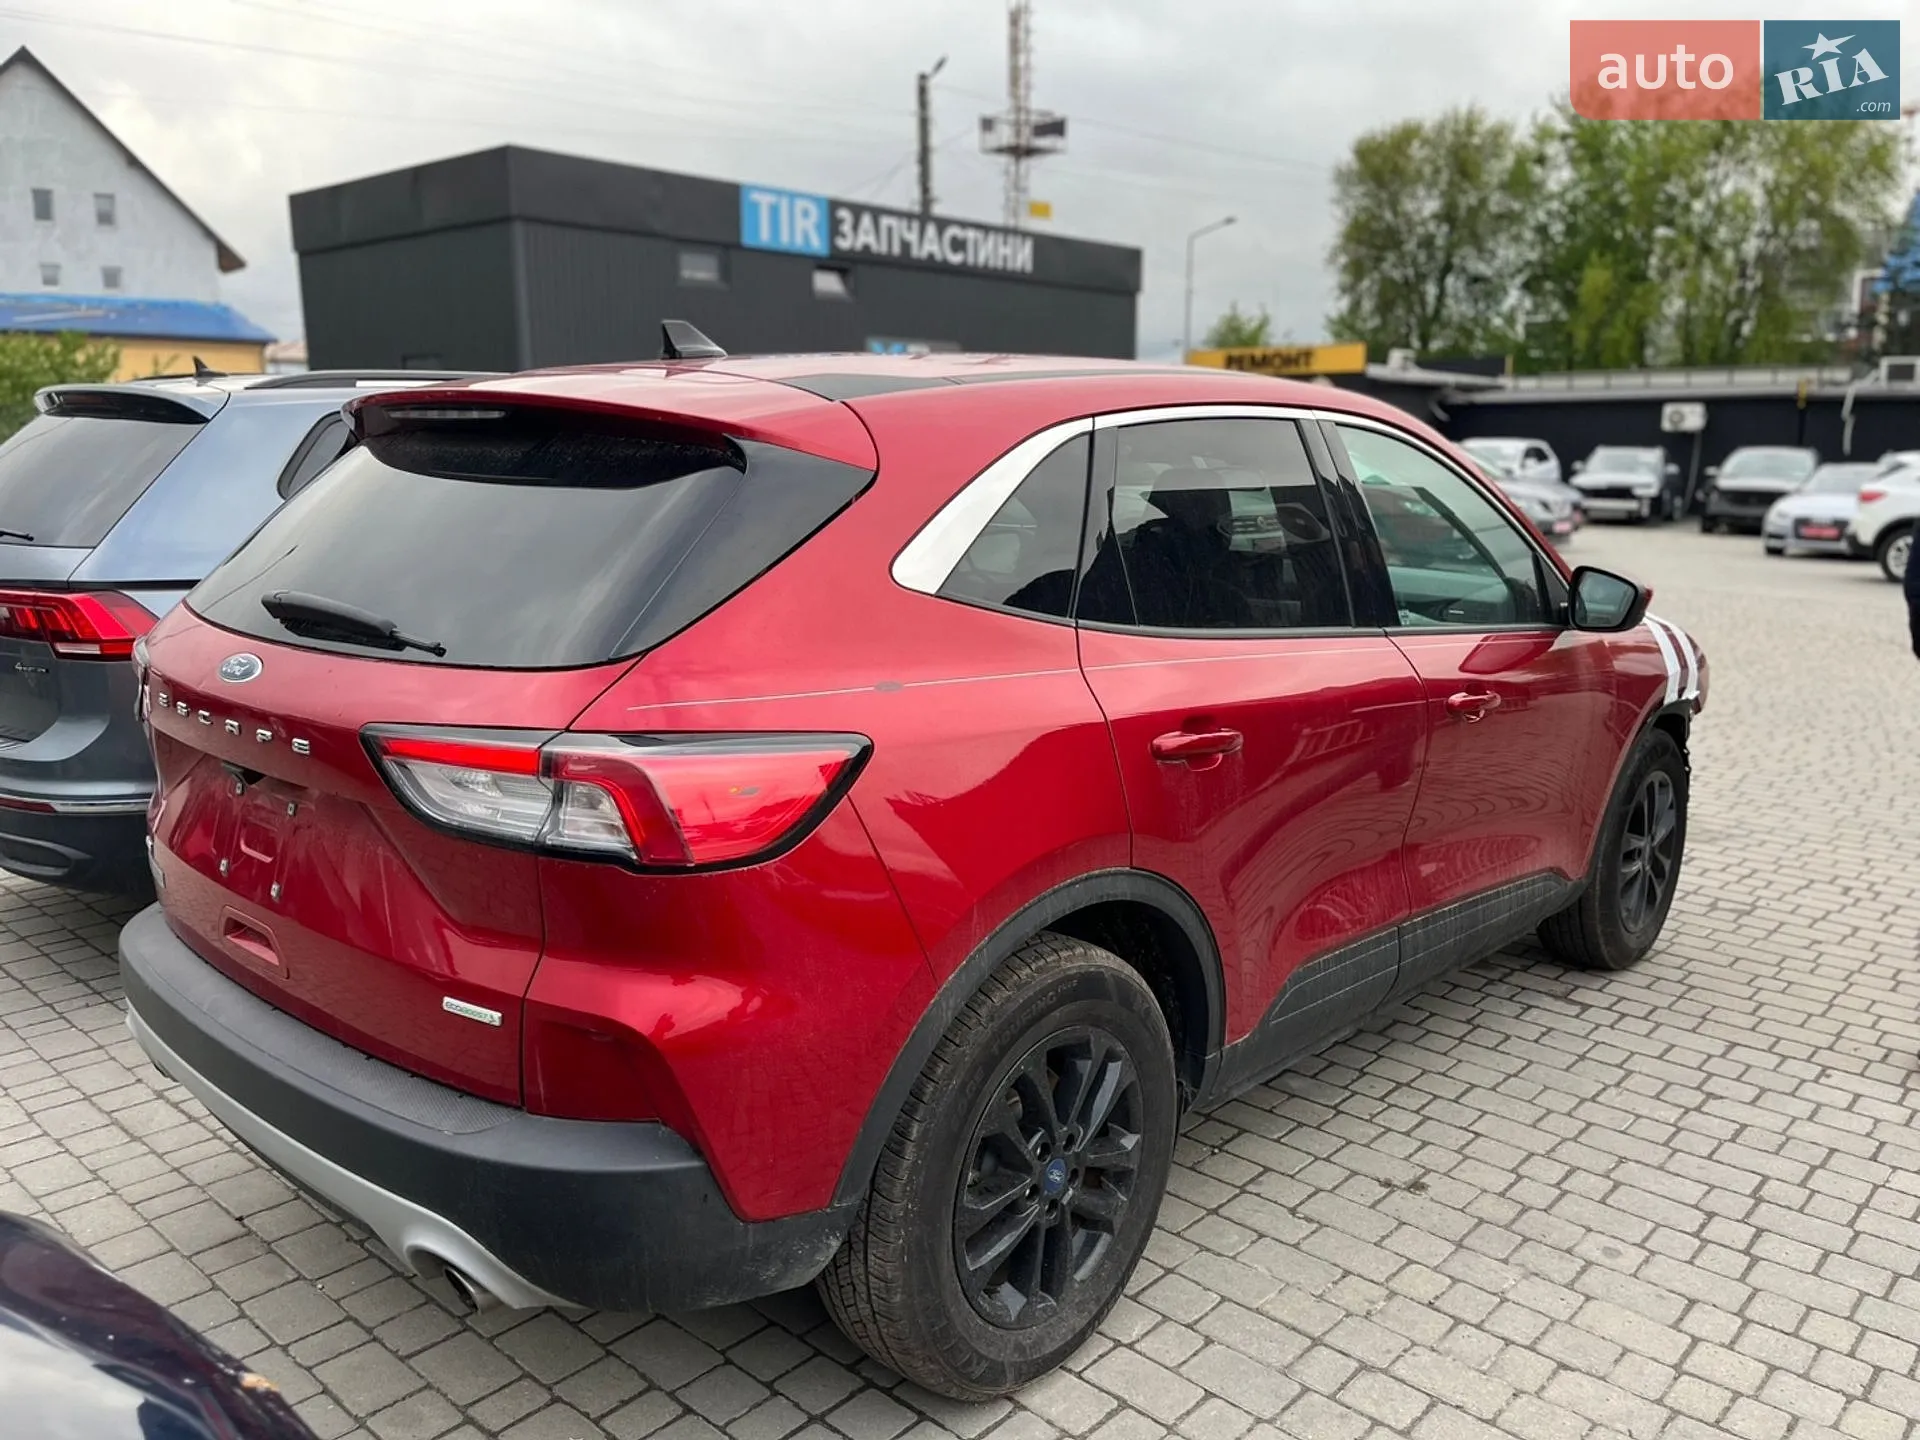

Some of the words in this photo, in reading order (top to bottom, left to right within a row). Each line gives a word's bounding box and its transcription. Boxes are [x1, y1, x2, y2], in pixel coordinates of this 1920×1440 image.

[752, 195, 821, 250] TIR
[834, 207, 1035, 274] ЗАПЧАСТИНИ
[158, 692, 311, 756] ESCAPE
